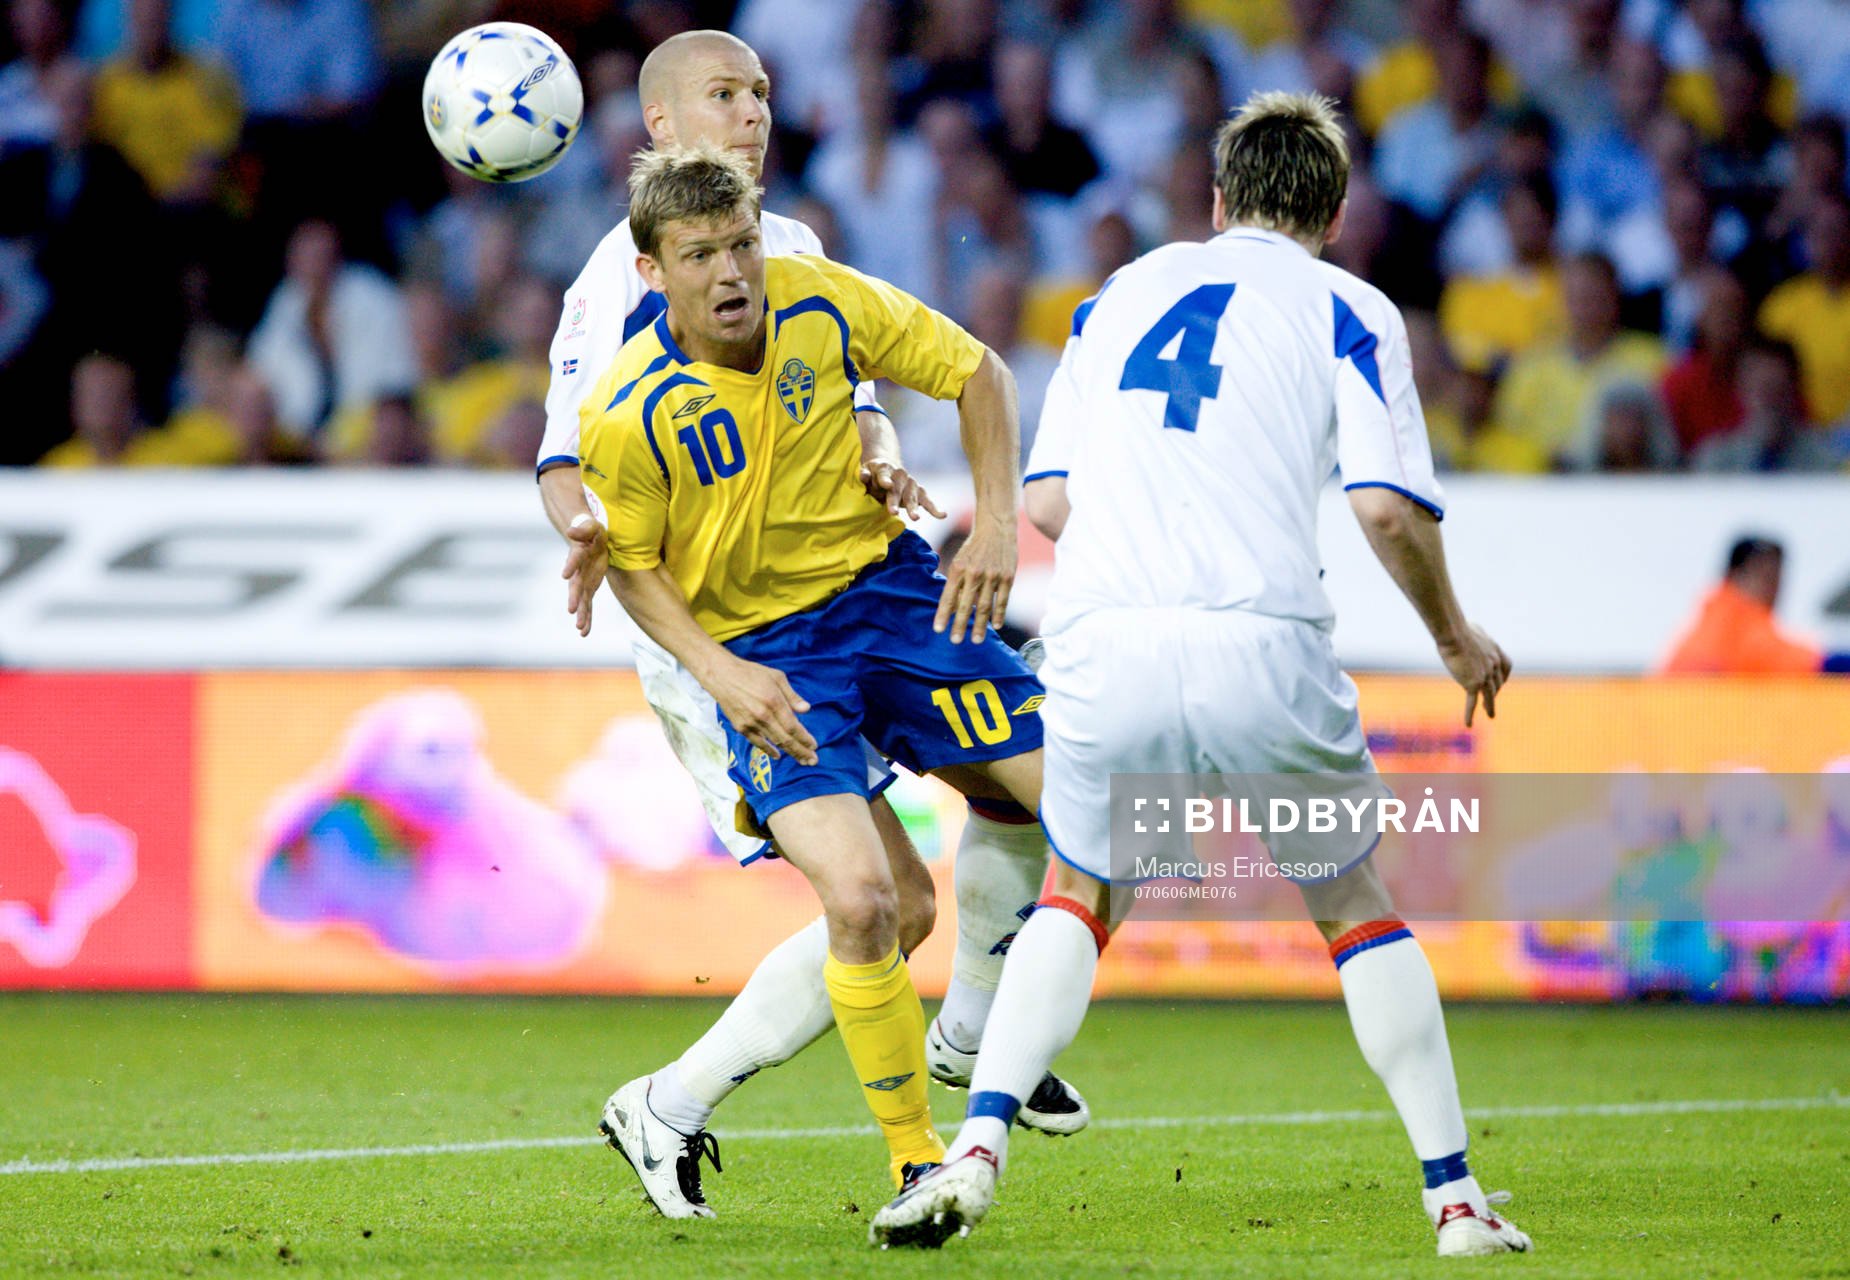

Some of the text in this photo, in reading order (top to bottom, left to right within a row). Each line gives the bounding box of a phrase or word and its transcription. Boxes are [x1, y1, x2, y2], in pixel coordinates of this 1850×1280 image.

[1119, 283, 1237, 433] 4
[677, 407, 747, 487] 10
[930, 679, 1012, 749] 10
